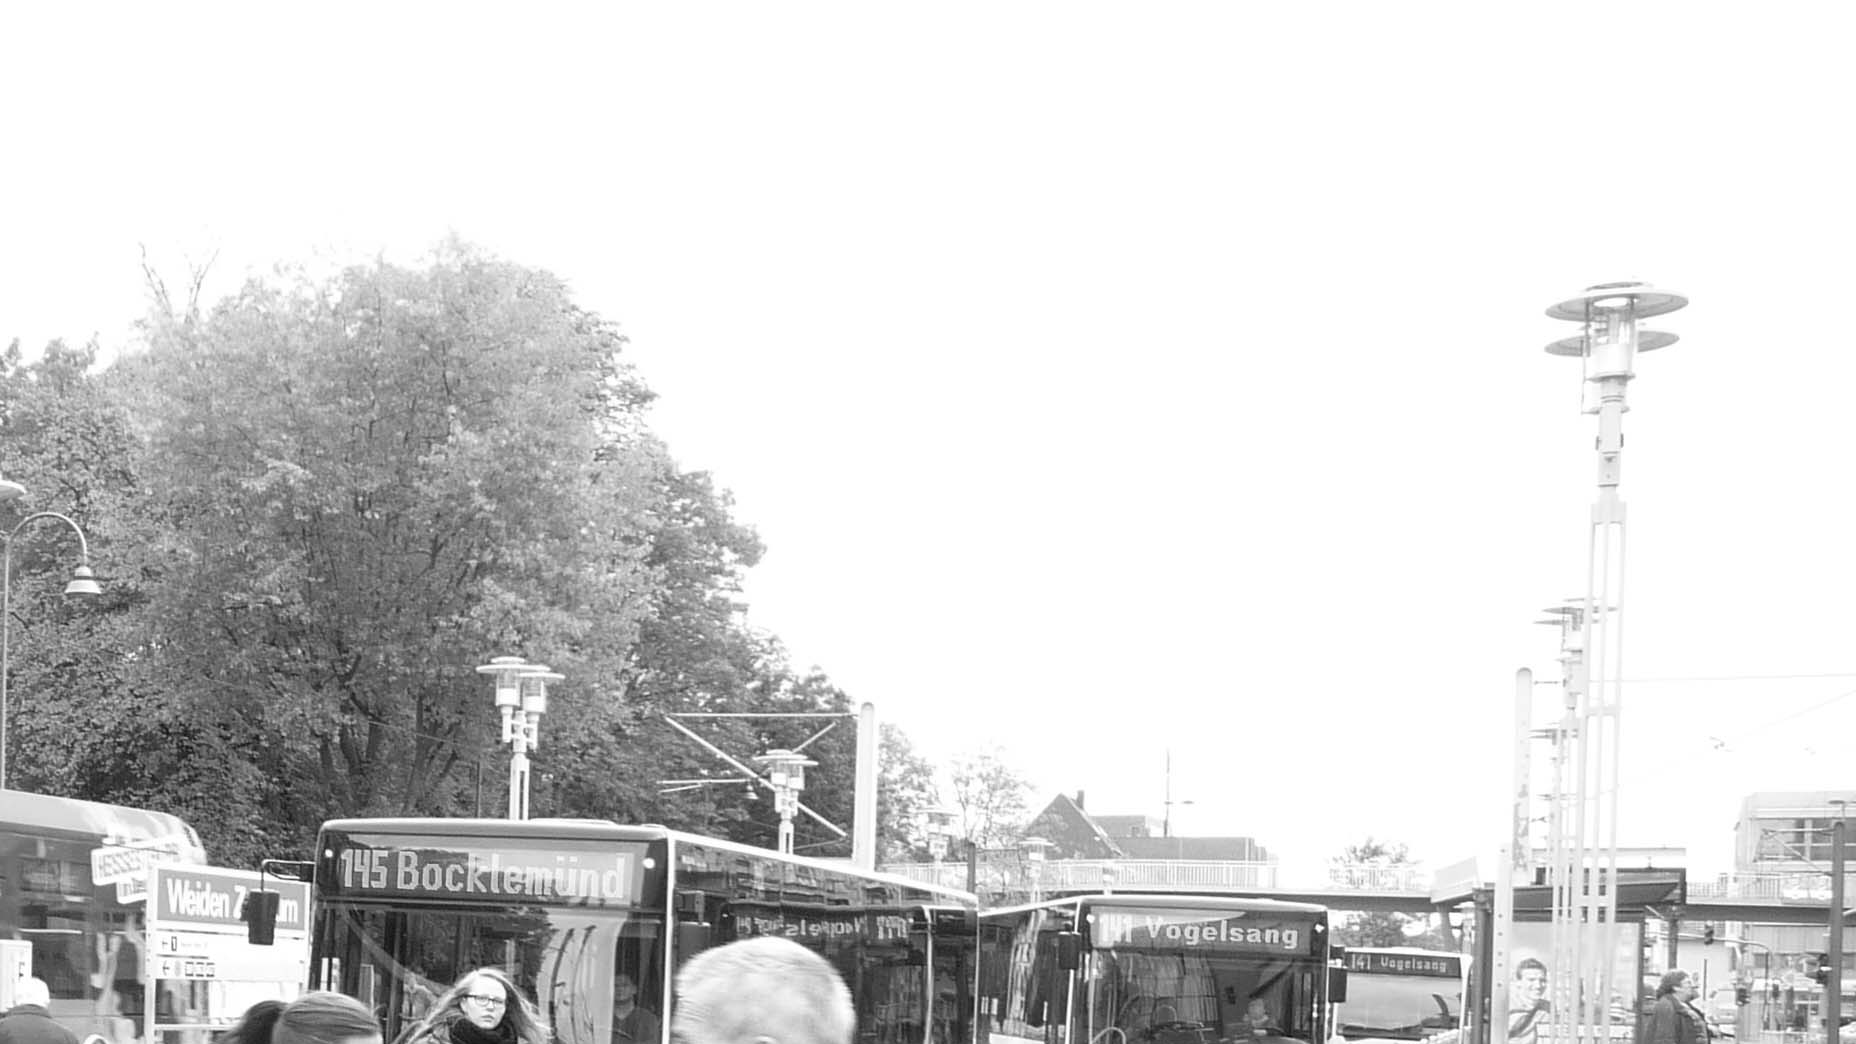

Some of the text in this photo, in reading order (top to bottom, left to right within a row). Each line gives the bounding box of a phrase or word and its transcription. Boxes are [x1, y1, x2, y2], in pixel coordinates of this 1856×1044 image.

[341, 849, 625, 899] 145 Bocklemünd
[166, 878, 229, 919] Weiden
[1146, 915, 1299, 950] Vogelsang
[1351, 953, 1447, 973] 141 Vogelsang
